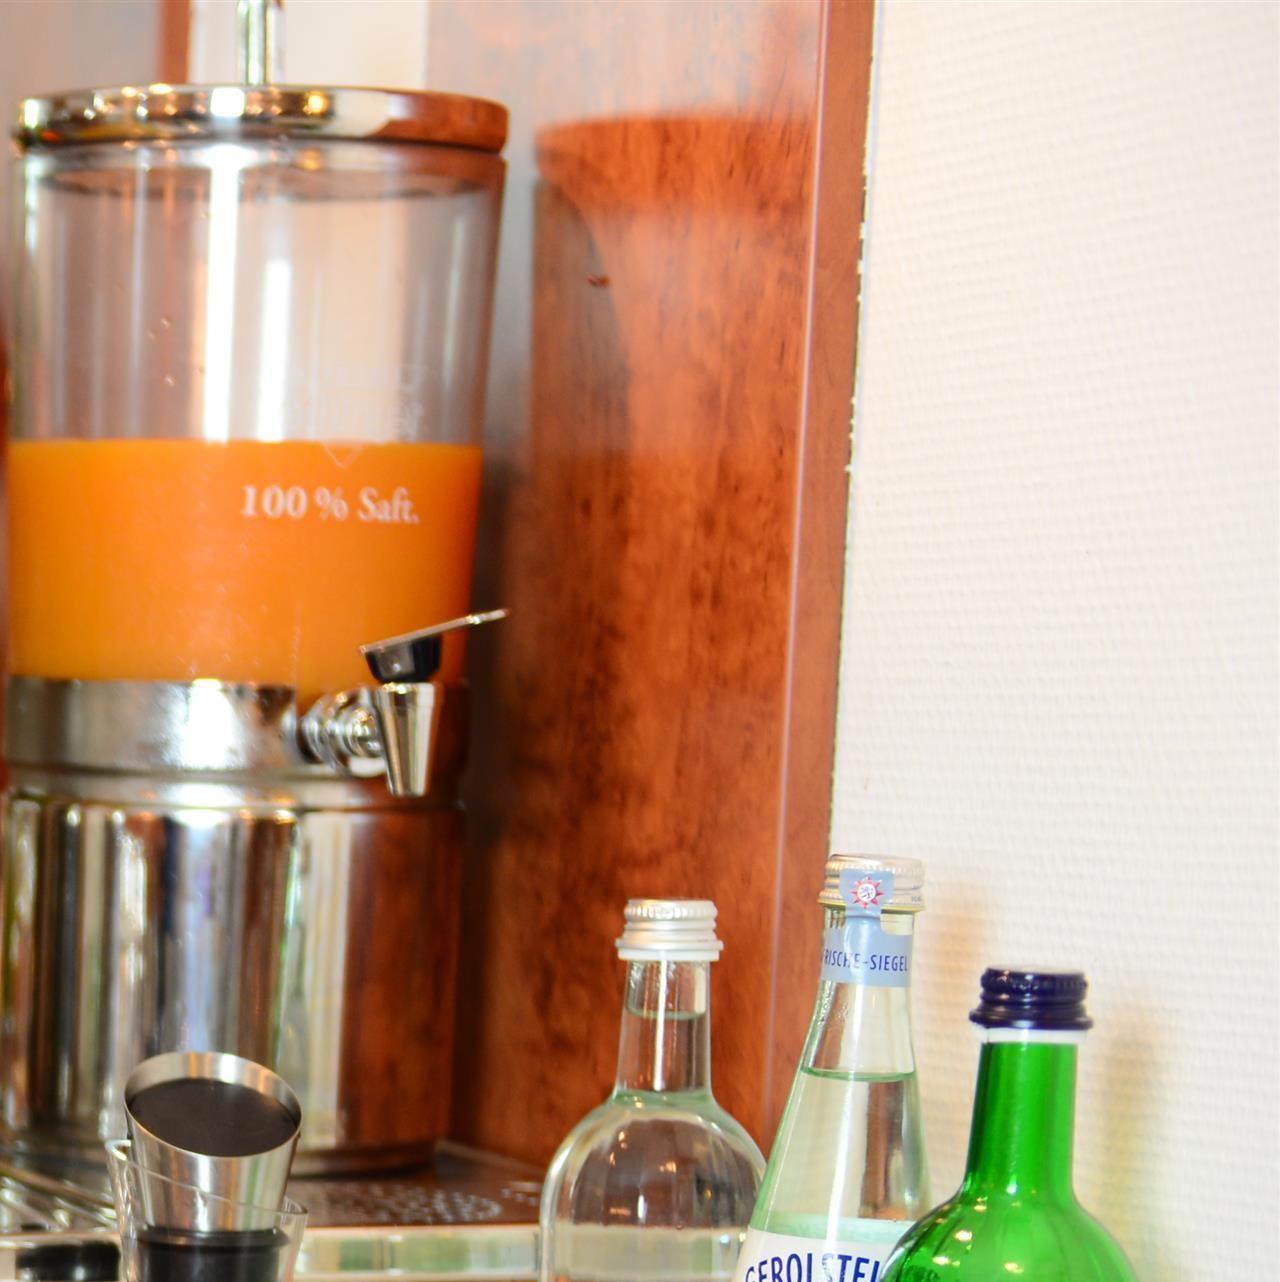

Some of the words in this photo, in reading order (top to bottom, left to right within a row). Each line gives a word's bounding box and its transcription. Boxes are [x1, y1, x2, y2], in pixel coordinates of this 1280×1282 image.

[241, 484, 307, 519] 100
[315, 486, 349, 521] %
[358, 486, 420, 525] Saft.
